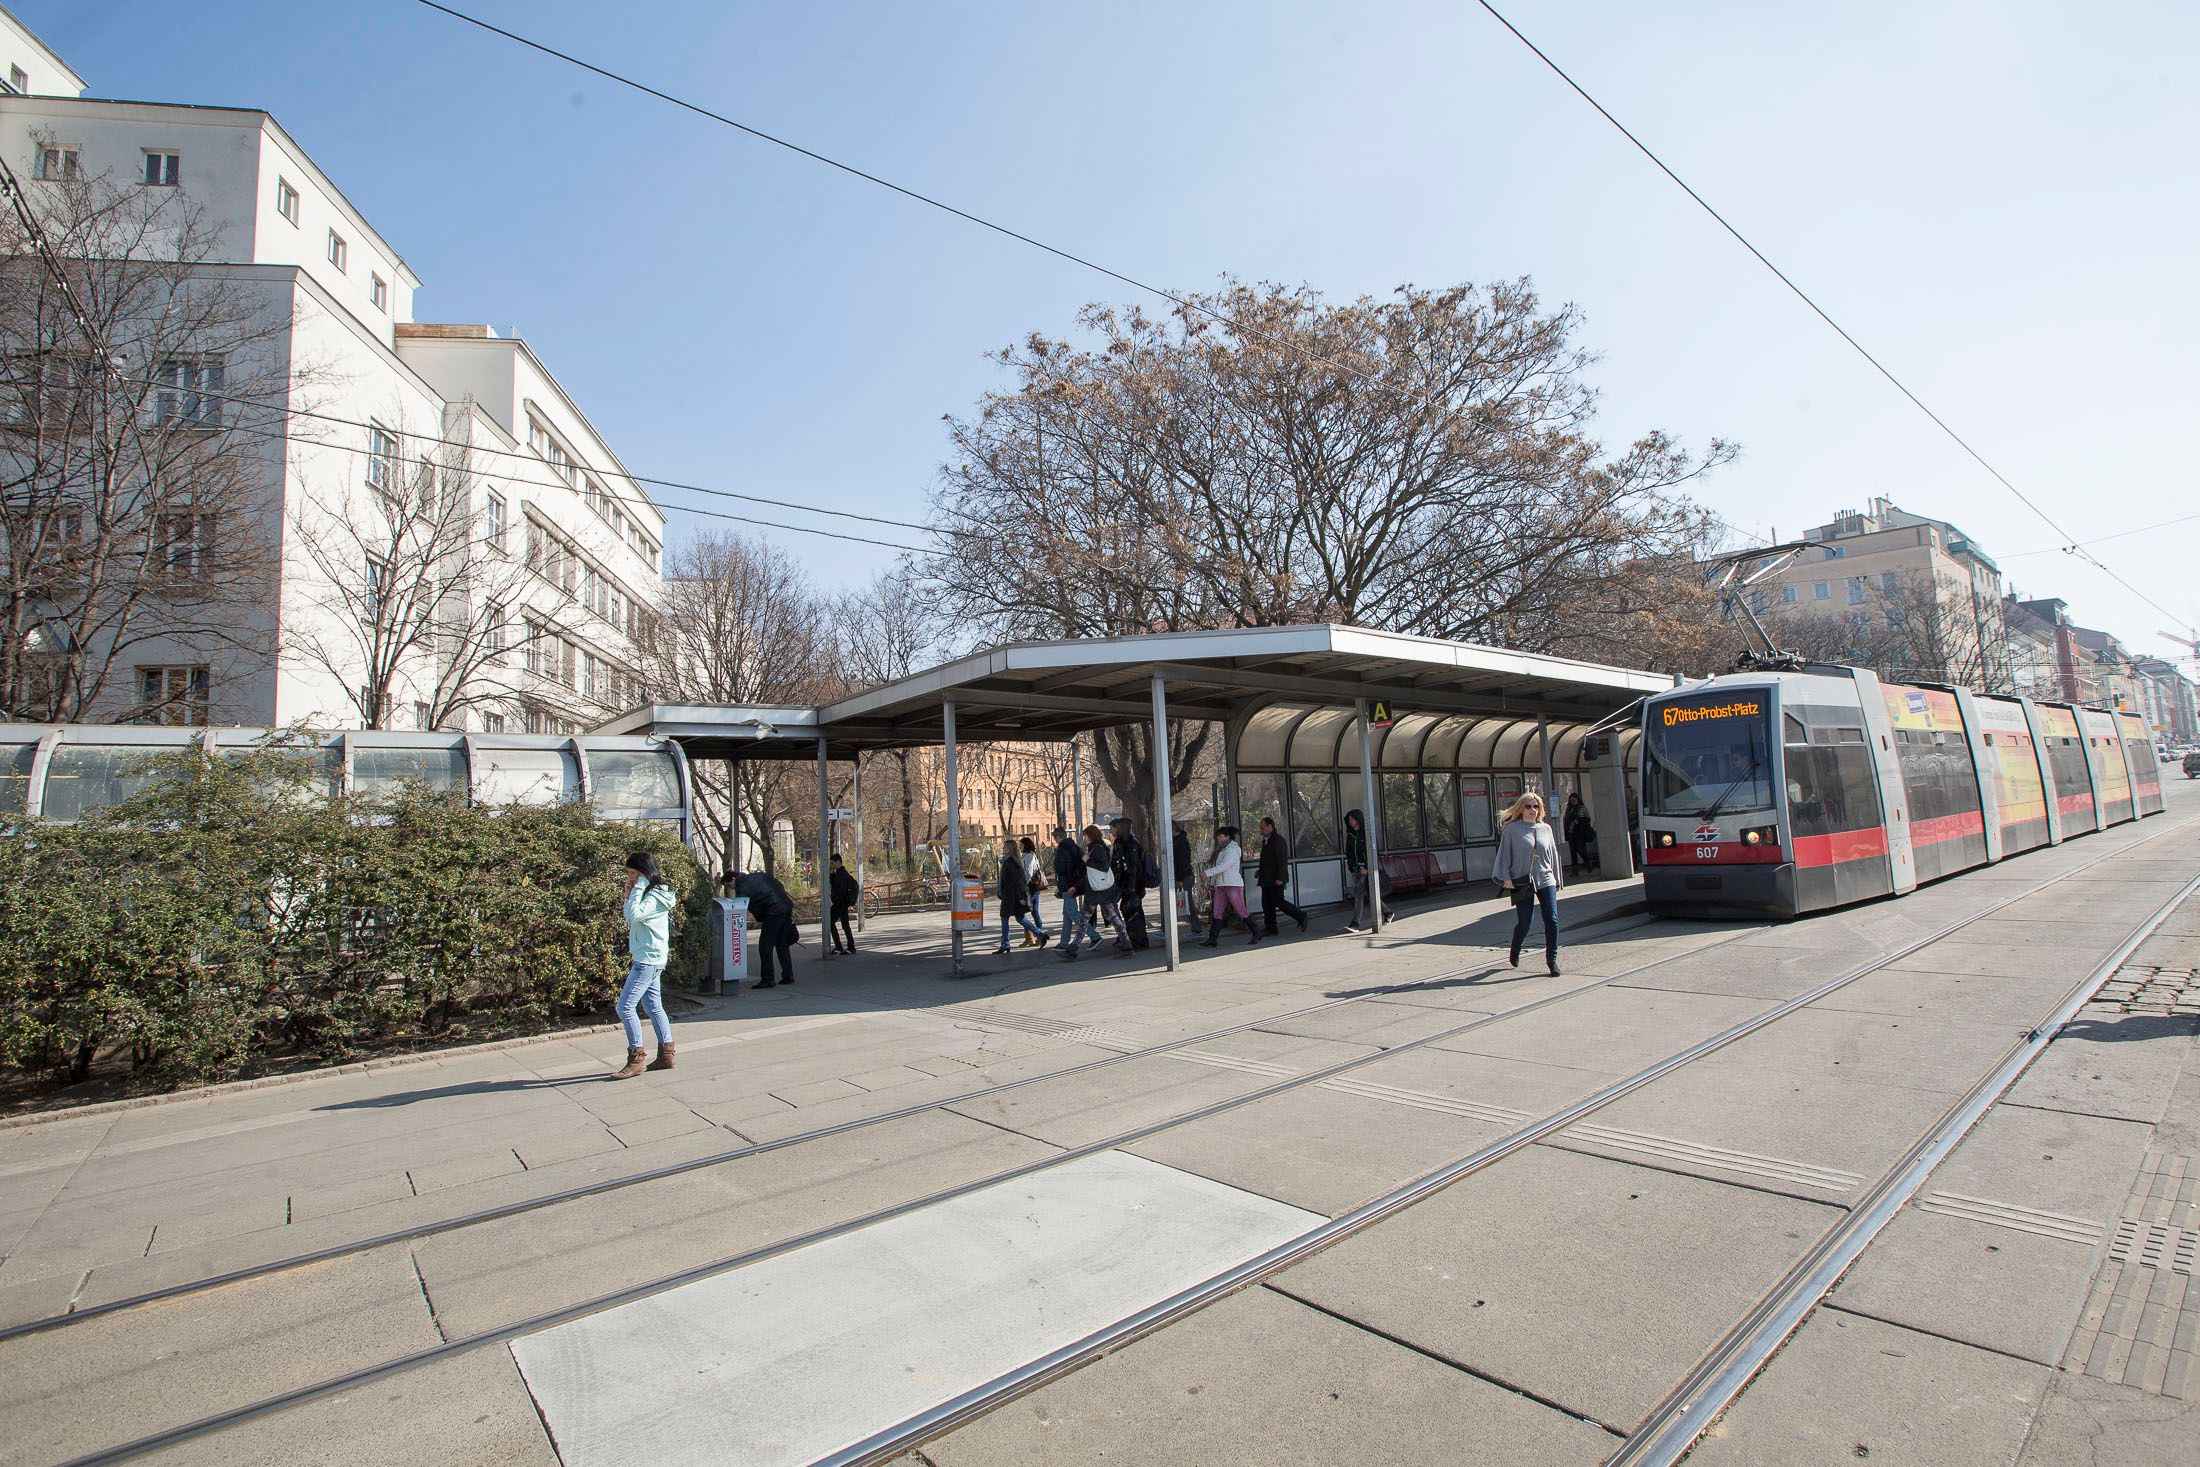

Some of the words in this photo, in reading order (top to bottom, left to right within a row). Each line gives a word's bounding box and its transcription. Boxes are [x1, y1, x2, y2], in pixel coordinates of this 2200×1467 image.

[1374, 702, 1388, 721] A
[1663, 707, 1678, 726] 67
[1678, 702, 1759, 722] Otto-Probst-Platz
[1696, 846, 1719, 859] 607
